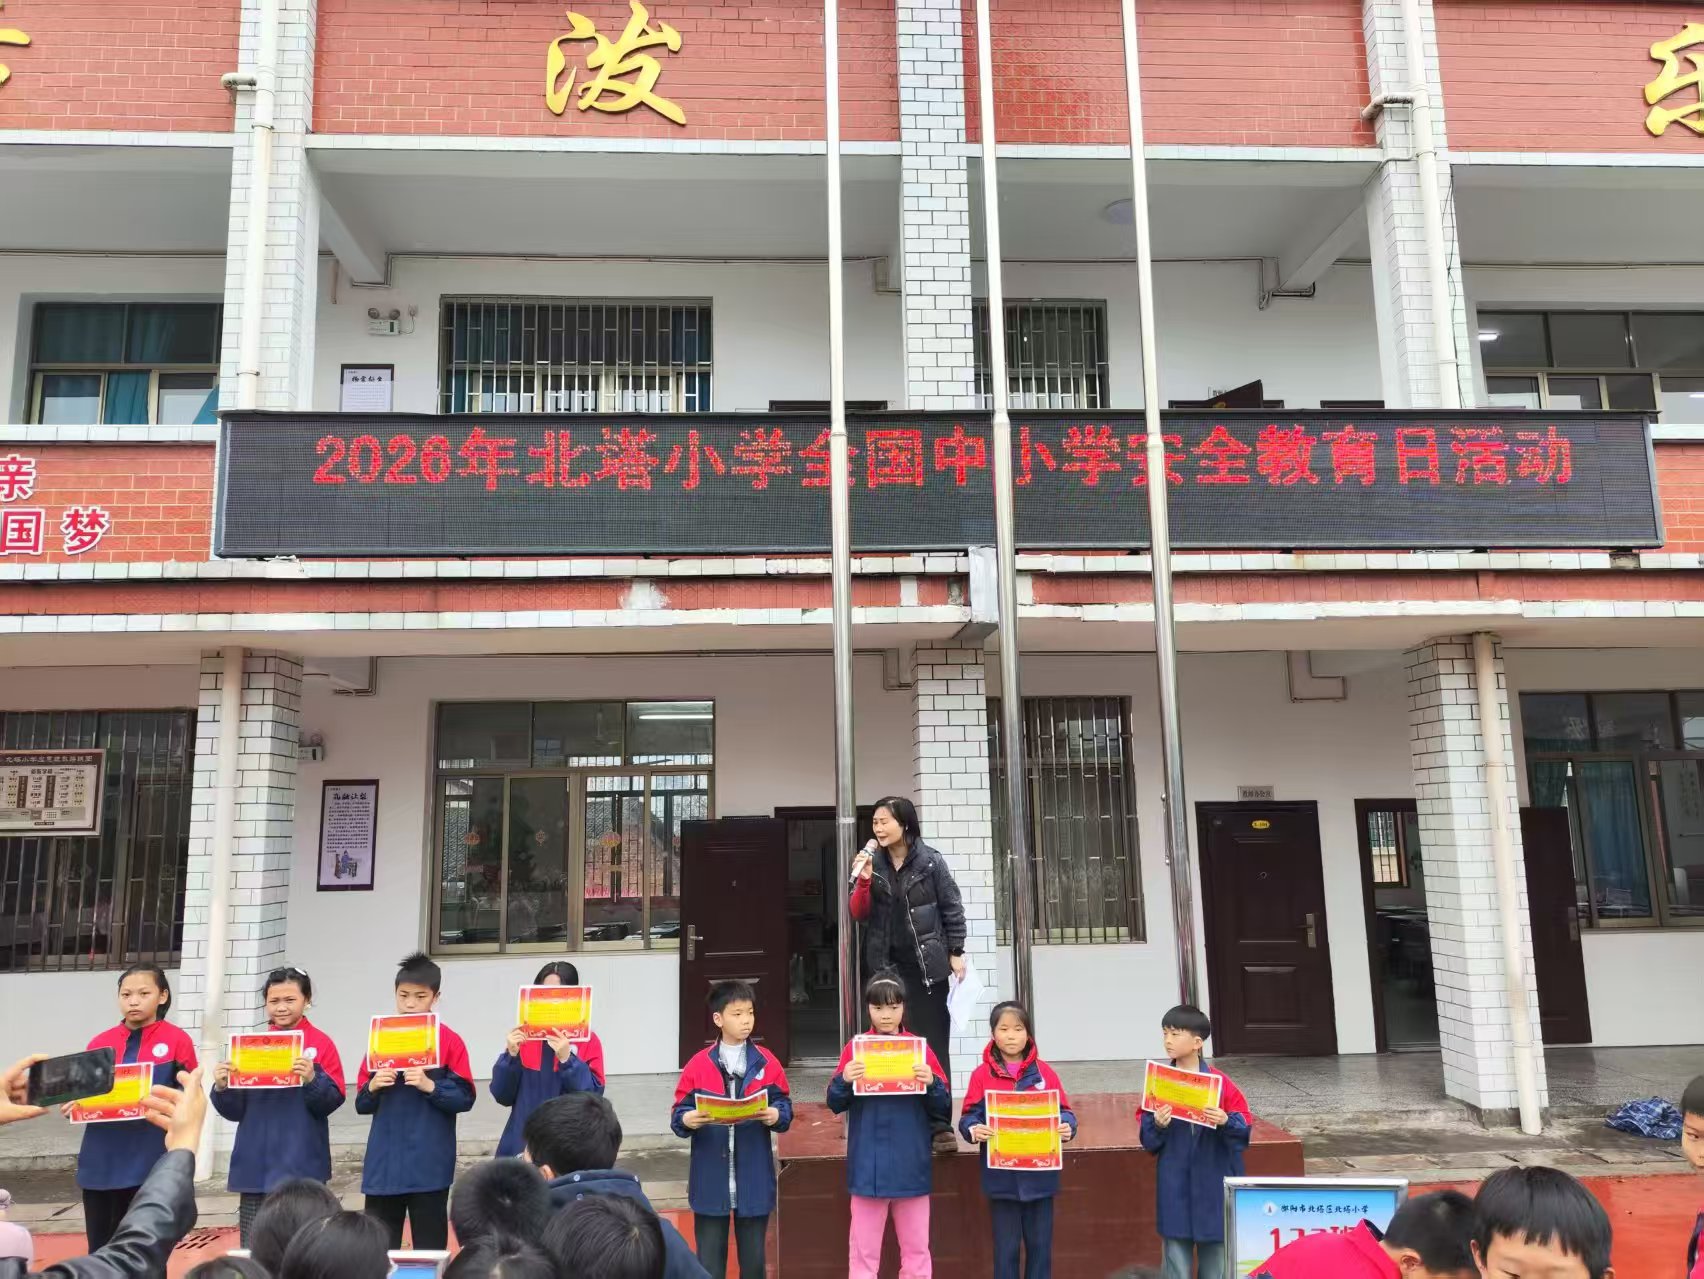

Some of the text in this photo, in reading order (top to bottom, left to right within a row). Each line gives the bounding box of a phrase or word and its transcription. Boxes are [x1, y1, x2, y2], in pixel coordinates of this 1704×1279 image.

[546, 0, 687, 125] 泼
[312, 424, 1574, 491] 2026年北塔小学全国中小学安全教育日活动
